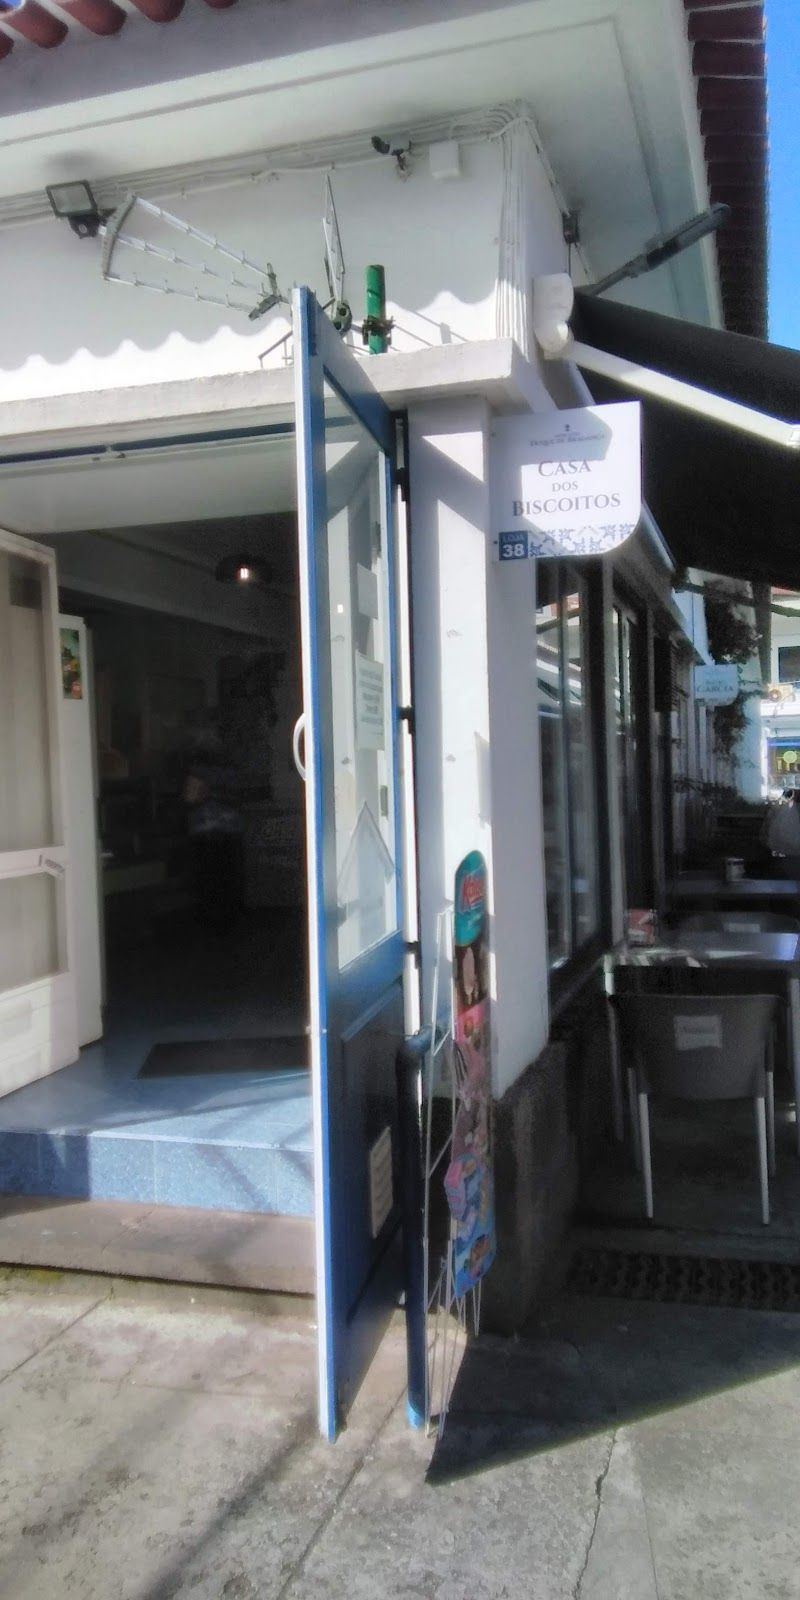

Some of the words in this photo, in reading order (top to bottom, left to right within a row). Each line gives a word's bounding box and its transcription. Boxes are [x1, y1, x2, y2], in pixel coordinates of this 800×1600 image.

[538, 460, 592, 477] CASA
[552, 480, 579, 493] DOS
[512, 493, 621, 517] BISCOITOS
[502, 543, 525, 558] 38
